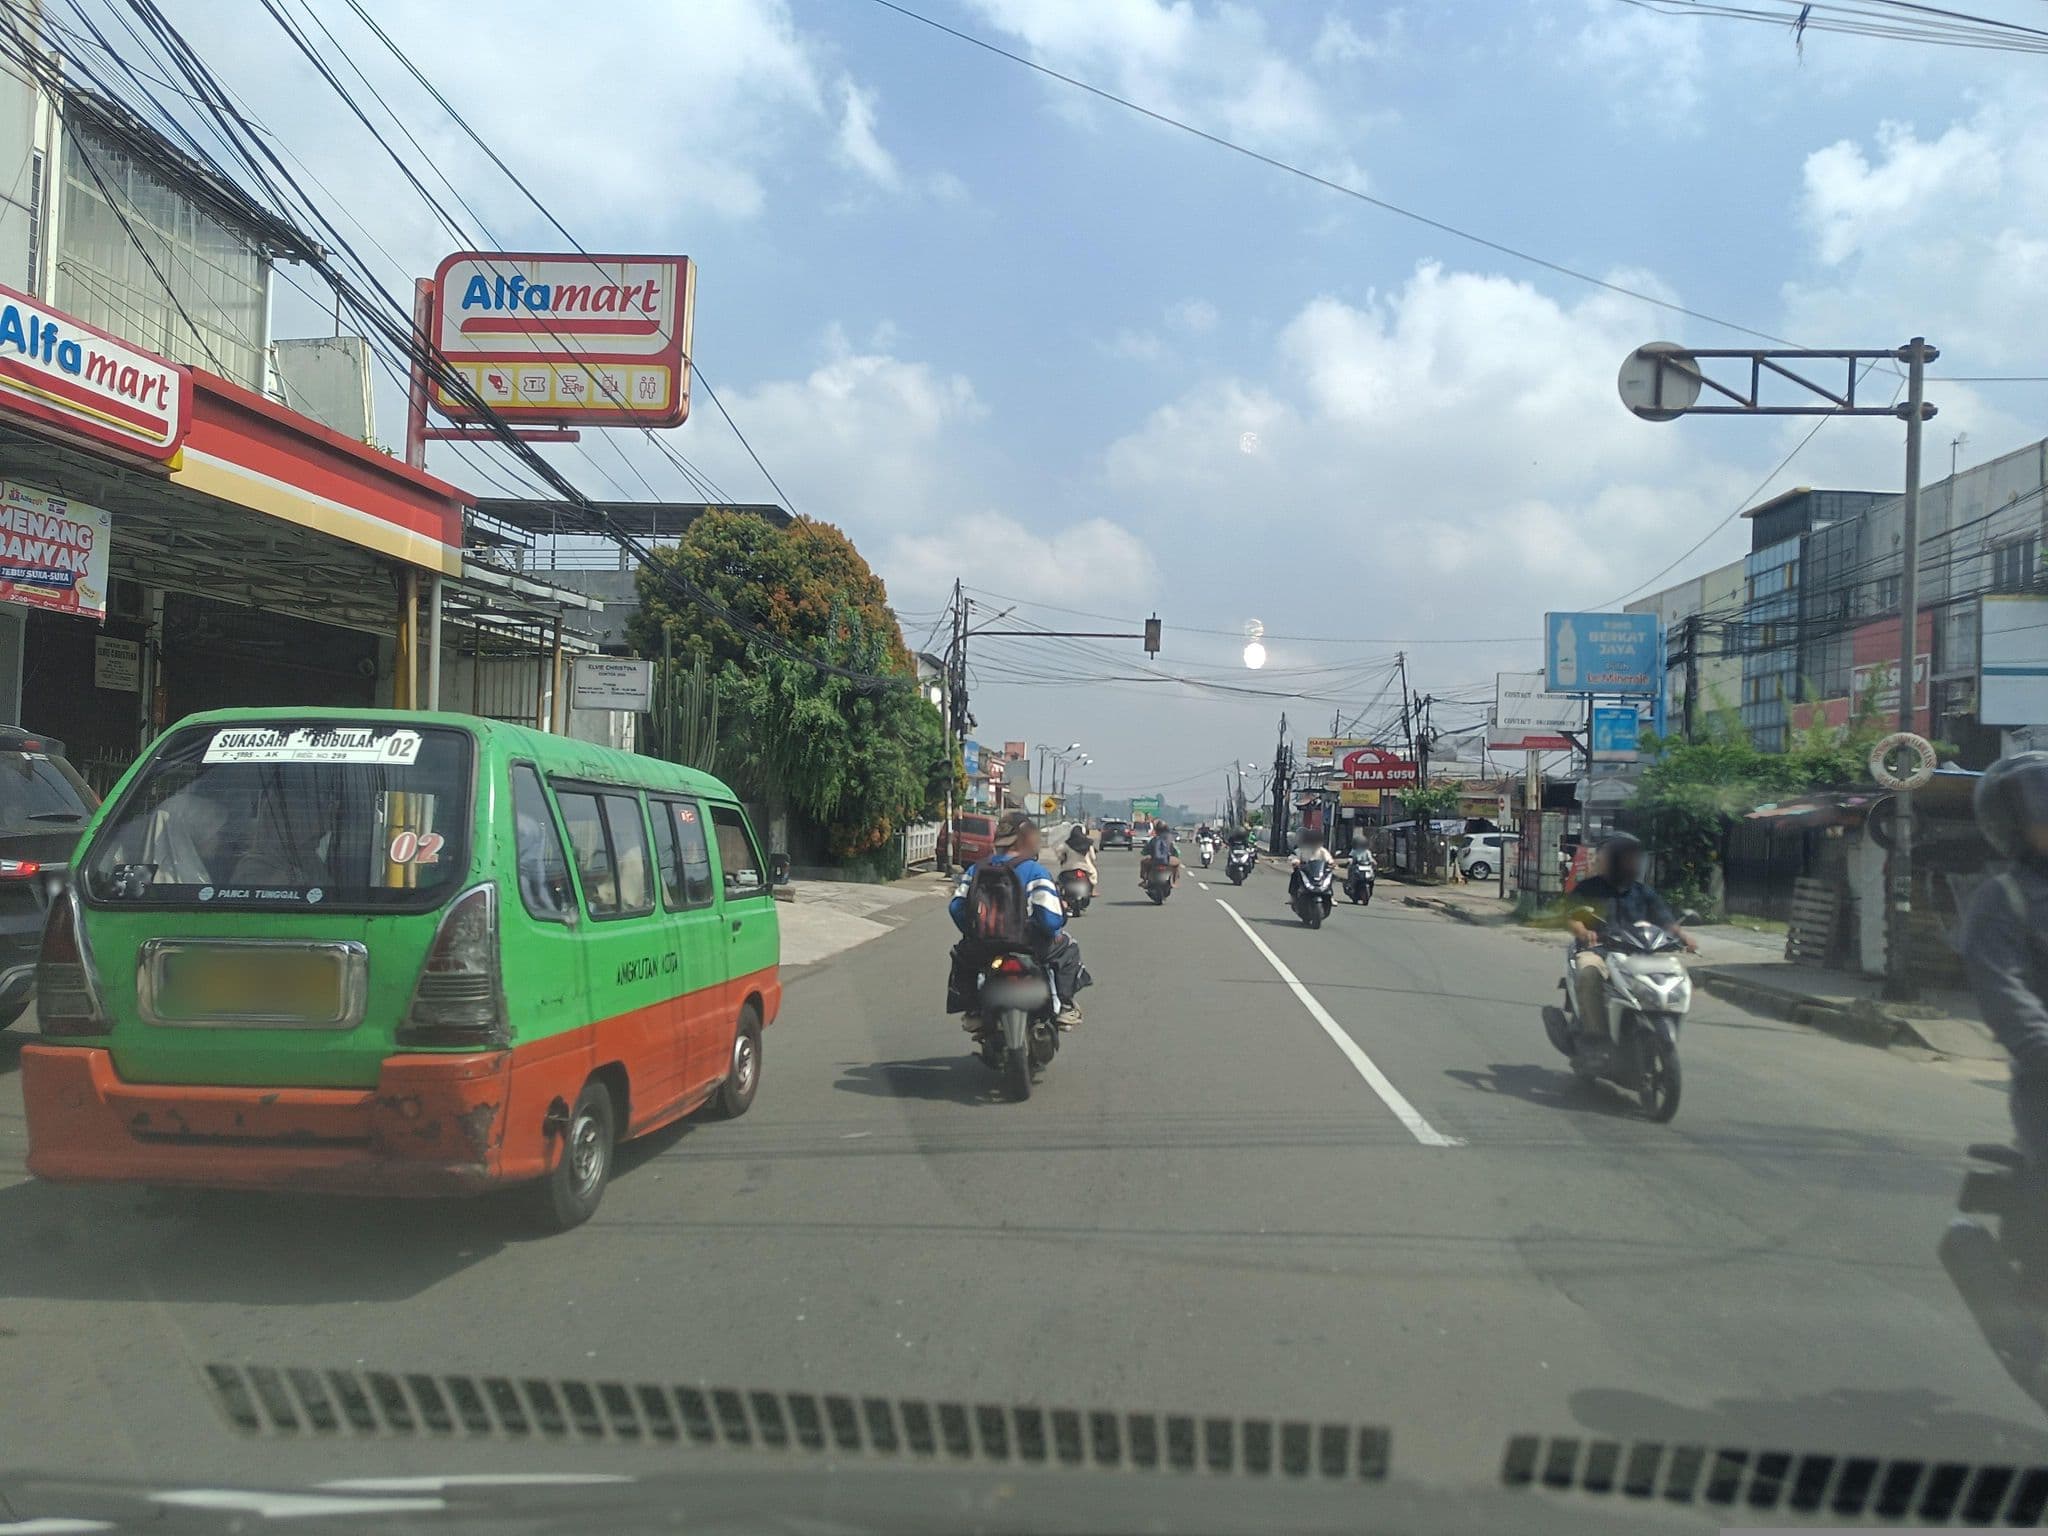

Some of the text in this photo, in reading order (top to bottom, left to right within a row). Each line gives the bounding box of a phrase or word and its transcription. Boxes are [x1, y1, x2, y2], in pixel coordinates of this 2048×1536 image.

[461, 275, 660, 313] Alfamart
[0, 304, 170, 411] Alfamart
[0, 507, 92, 550] MENANG
[1588, 631, 1646, 643] BERKAT
[219, 734, 288, 748] SUKASARI
[387, 737, 415, 758] 02
[1355, 770, 1415, 779] RAJA SUSU
[390, 831, 445, 863] 02
[217, 889, 300, 900] PANCA TUNGGAL
[616, 955, 659, 986] ANGKUTAN
